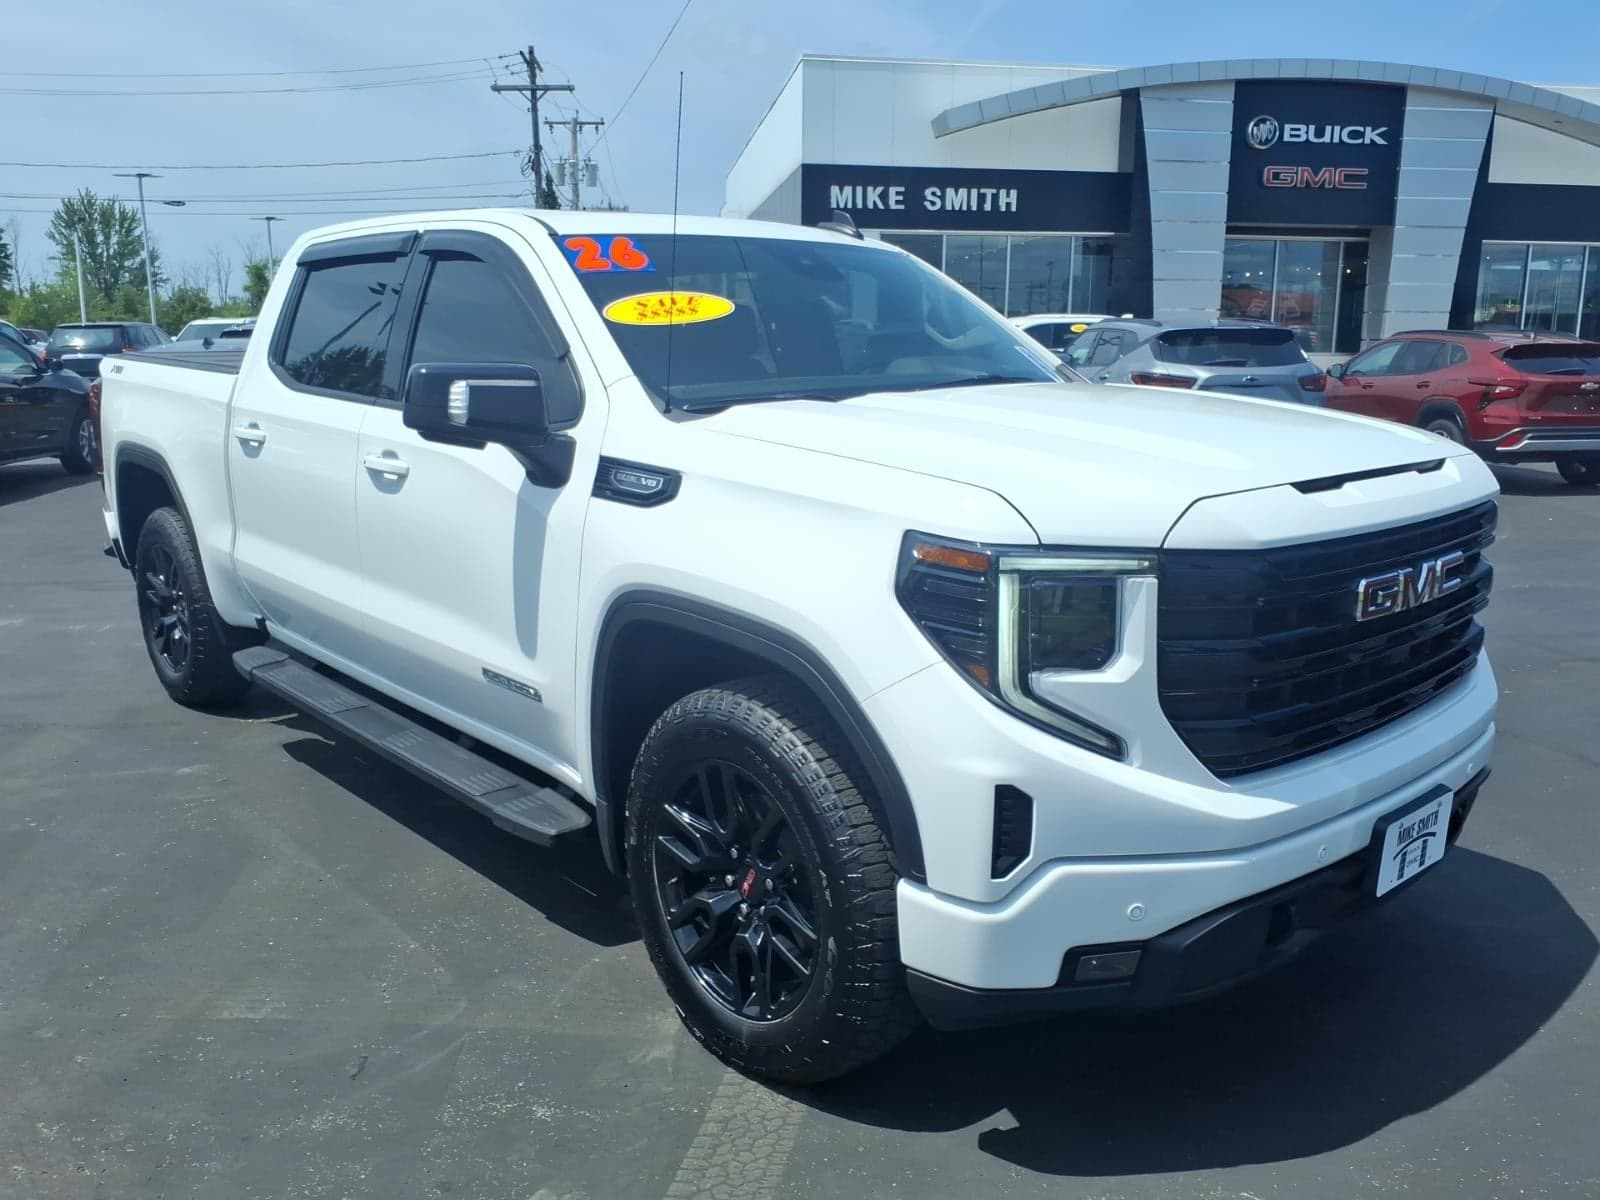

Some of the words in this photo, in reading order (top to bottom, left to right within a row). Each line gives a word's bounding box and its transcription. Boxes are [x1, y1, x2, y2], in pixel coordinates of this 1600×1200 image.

[1283, 124, 1389, 145] BUICK
[1263, 165, 1369, 189] GMC
[830, 185, 906, 210] MIKE
[924, 186, 1018, 212] SMITH
[563, 236, 649, 271] 26
[1356, 550, 1465, 622] GMC
[1397, 822, 1416, 846] MIKE
[1417, 810, 1440, 833] SMITH
